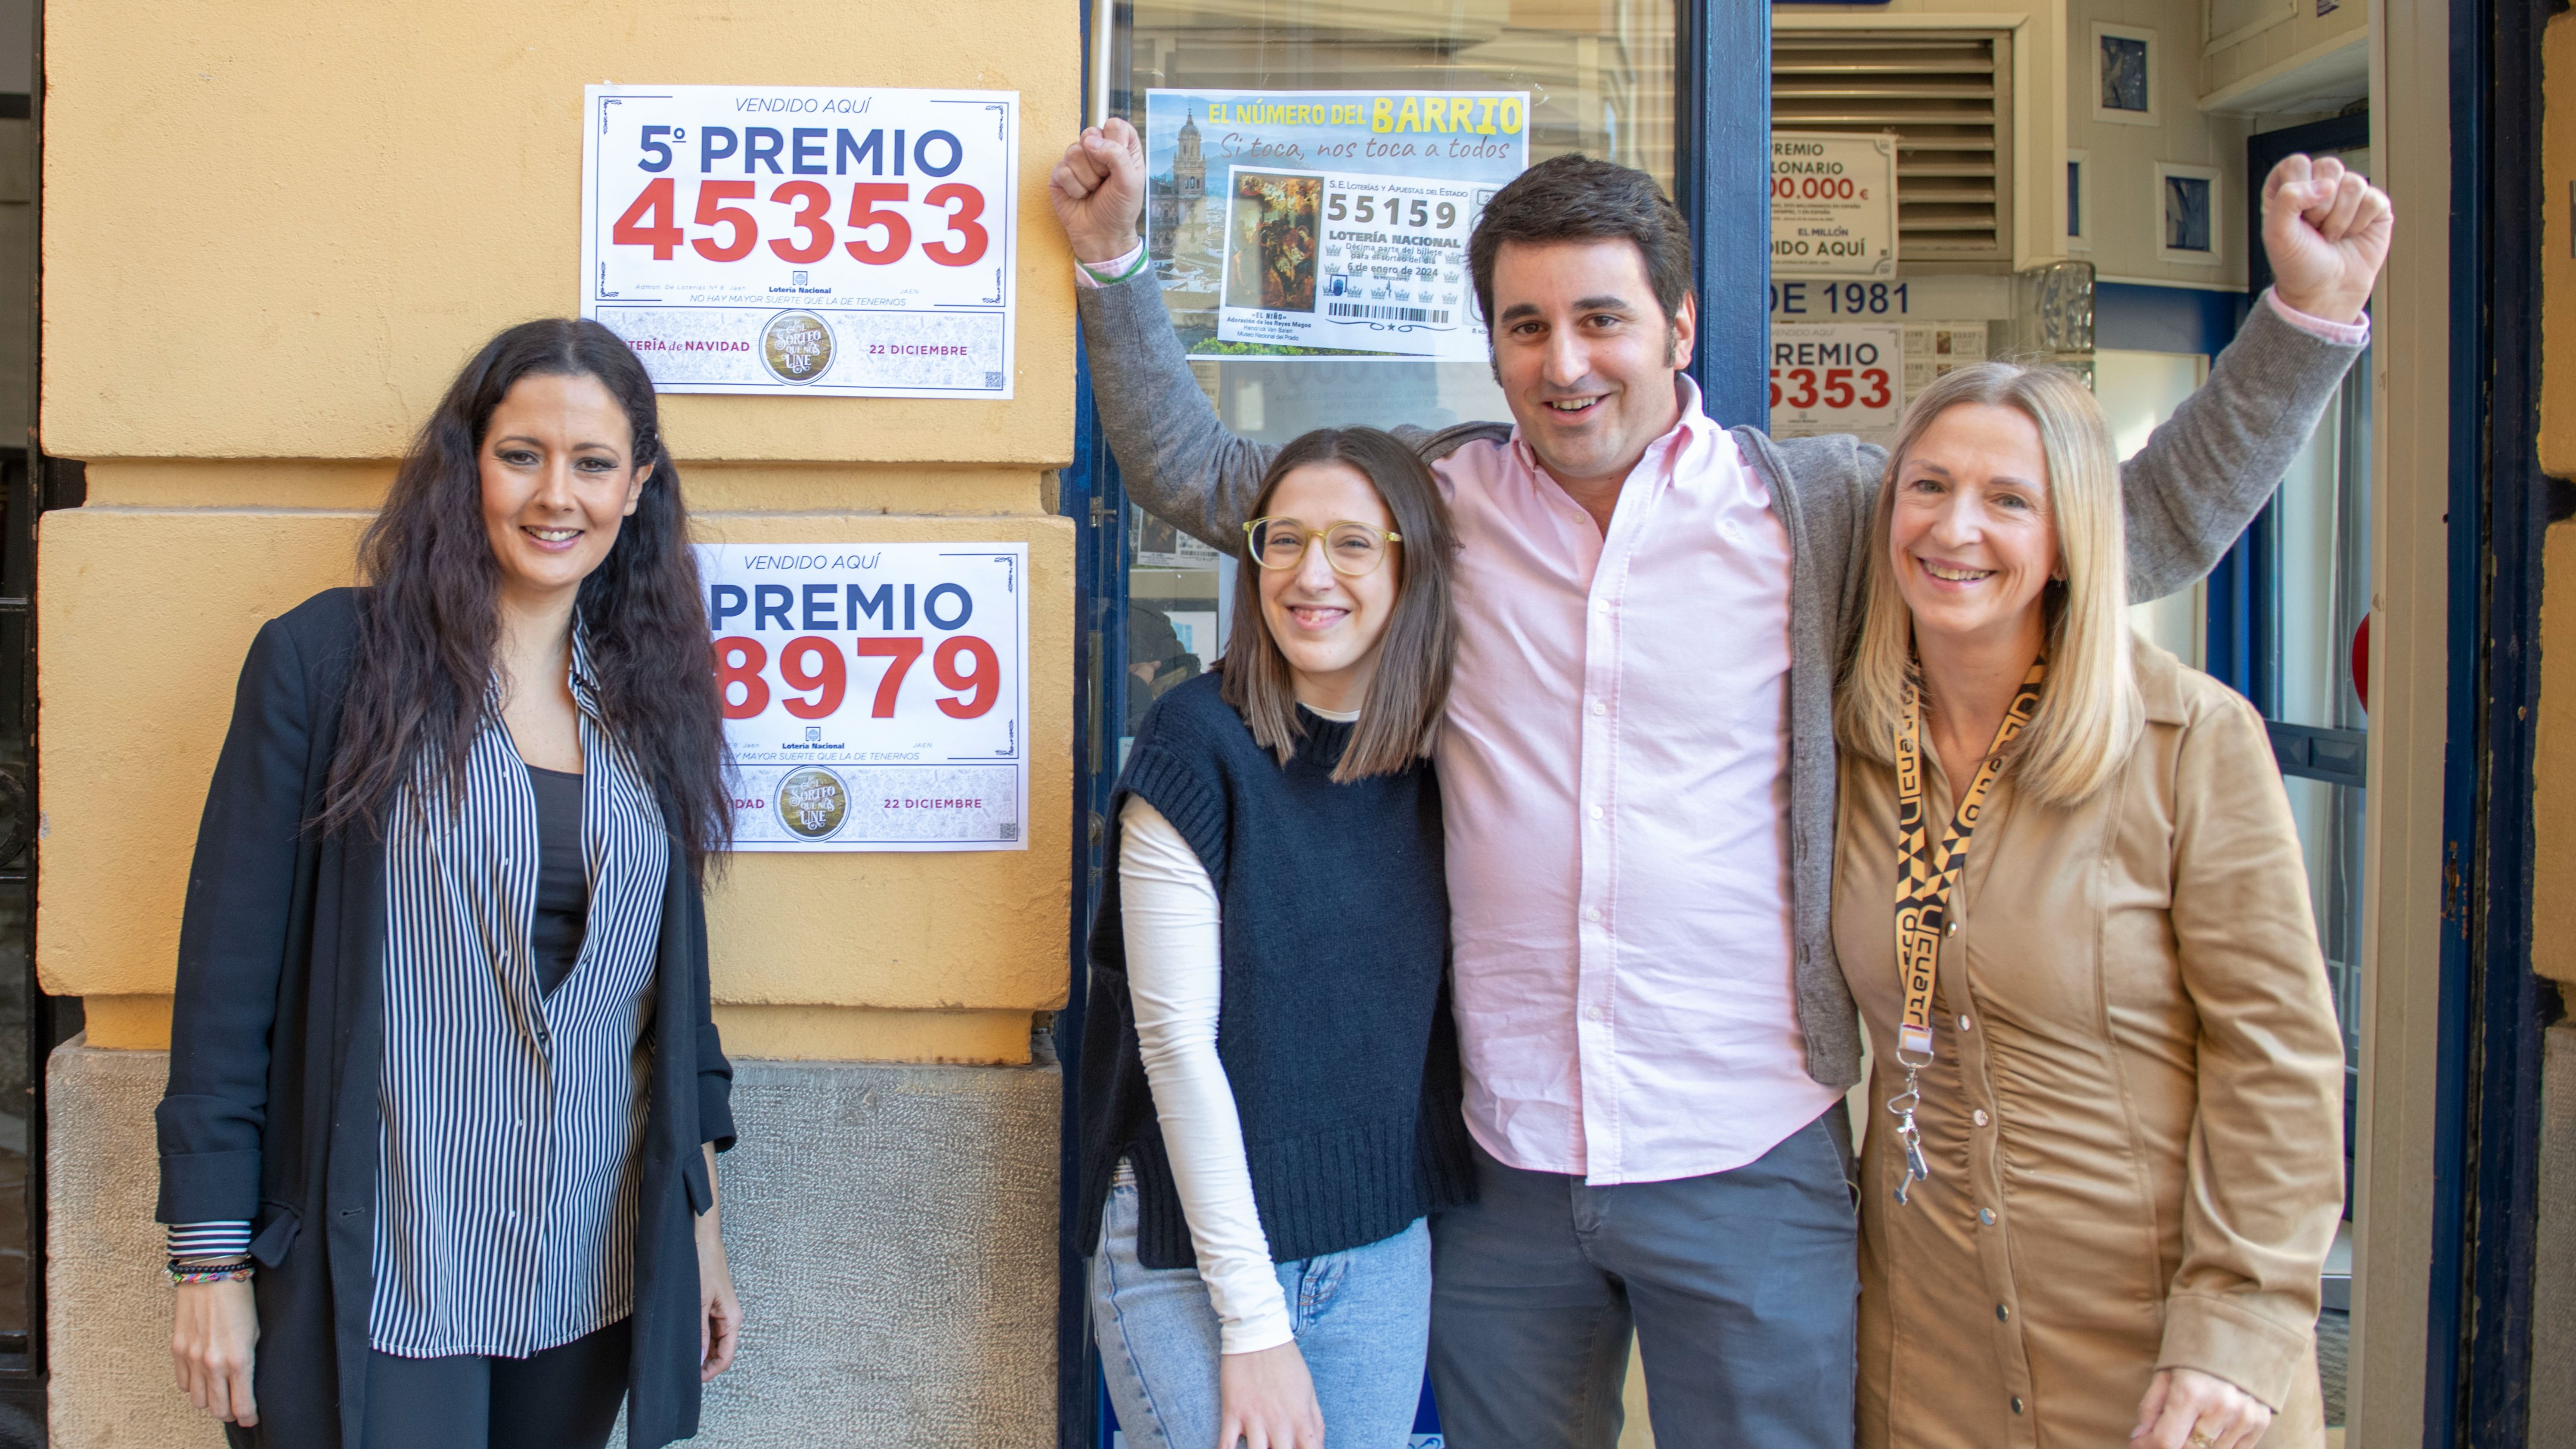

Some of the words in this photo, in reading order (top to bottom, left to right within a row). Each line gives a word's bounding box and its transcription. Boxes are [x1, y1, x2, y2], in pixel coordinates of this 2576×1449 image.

[736, 98, 818, 113] VENDIDO
[823, 97, 871, 115] AQUÍ
[1209, 104, 1229, 124] EL
[1236, 98, 1325, 125] NÚMERO
[1331, 105, 1367, 125] DEL
[1371, 97, 1523, 135] BARRIO
[638, 125, 686, 173] 5º
[701, 126, 963, 178] PREMIO
[1221, 132, 1242, 159] Si
[1251, 138, 1305, 160] toca,
[1317, 142, 1357, 158] nos
[1366, 137, 1417, 158] toca
[1424, 143, 1439, 157] a
[1448, 136, 1510, 159] todos
[1771, 143, 1824, 156] REMIO
[1771, 161, 1844, 174] LONARIO
[1388, 184, 1424, 194] APUESTAS
[1439, 188, 1468, 197] ESTADO
[1327, 193, 1456, 230] 55159
[612, 178, 989, 267] 45353
[1798, 228, 1808, 236] EL
[1812, 225, 1849, 236] MILLÓN
[1329, 230, 1387, 243] LOTERÍA
[1392, 235, 1460, 248] NACIONAL
[1817, 238, 1866, 257] AQUÍ
[1345, 242, 1375, 251] Décima
[1378, 246, 1399, 254] parte
[1402, 246, 1414, 254] del
[1417, 247, 1442, 256] billete
[1409, 255, 1422, 264] del
[1356, 263, 1367, 272] de
[1371, 266, 1398, 274] enero
[1401, 265, 1413, 274] de
[1416, 267, 1438, 276] 2024
[856, 298, 906, 306] TENERNOS
[1824, 282, 1908, 314] 1981
[628, 338, 666, 351] TERÍA
[669, 341, 682, 351] de
[685, 341, 750, 351] NAVIDAD
[869, 344, 885, 354] 22
[890, 345, 967, 356] DICIEMBRE
[1770, 342, 1879, 366] REMIO
[1770, 368, 1892, 409] 5353
[744, 556, 827, 570] VENDIDO
[831, 552, 881, 571] AQUÍ
[711, 582, 973, 631] PREMIO
[713, 636, 1000, 719] 8979
[742, 752, 777, 760] MAYOR
[779, 752, 815, 760] SUERTE
[817, 752, 838, 760] QUE
[854, 752, 868, 760] DE
[869, 752, 920, 760] TENERNOS
[884, 800, 900, 808] 22
[905, 799, 983, 809] DICIEMBRE
